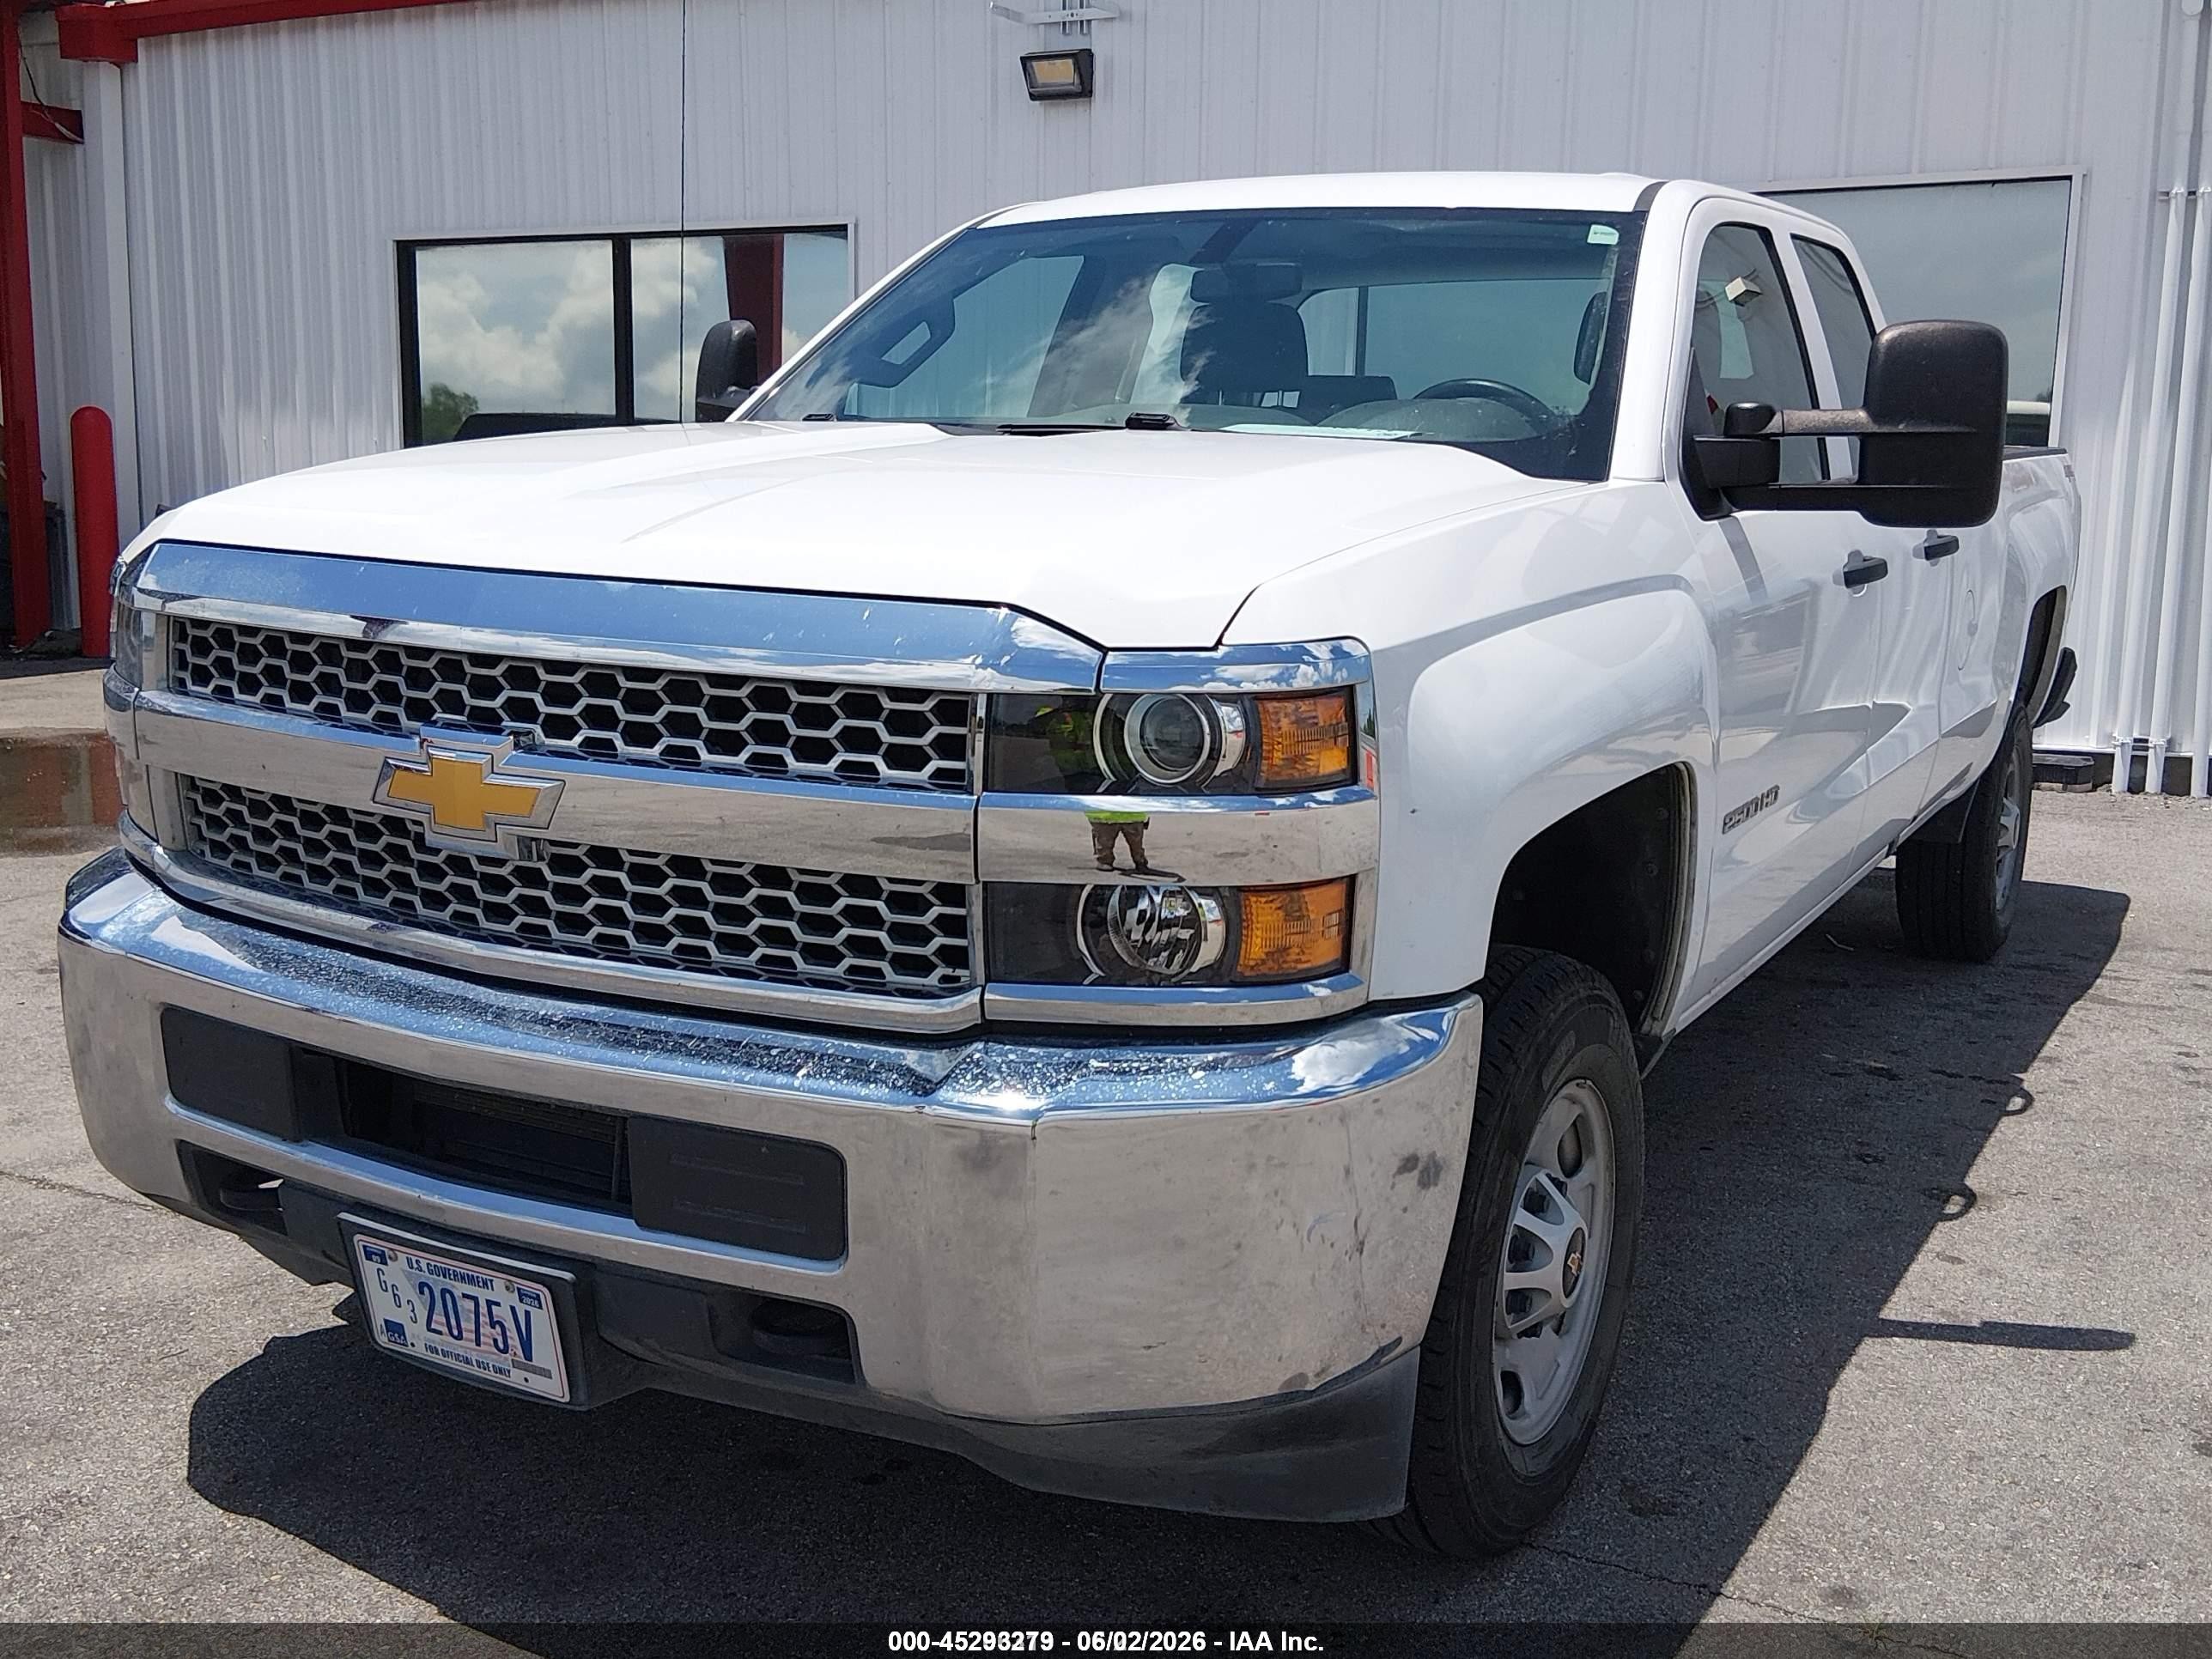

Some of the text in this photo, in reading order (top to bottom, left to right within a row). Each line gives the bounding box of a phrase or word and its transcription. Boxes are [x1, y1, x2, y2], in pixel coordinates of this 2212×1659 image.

[406, 1256, 495, 1292] U.S. GOVERNMENT
[387, 1330, 408, 1346] GSA
[418, 1280, 534, 1363] 2075V
[424, 1342, 512, 1379] FOR OFFICIAL USE ONLY
